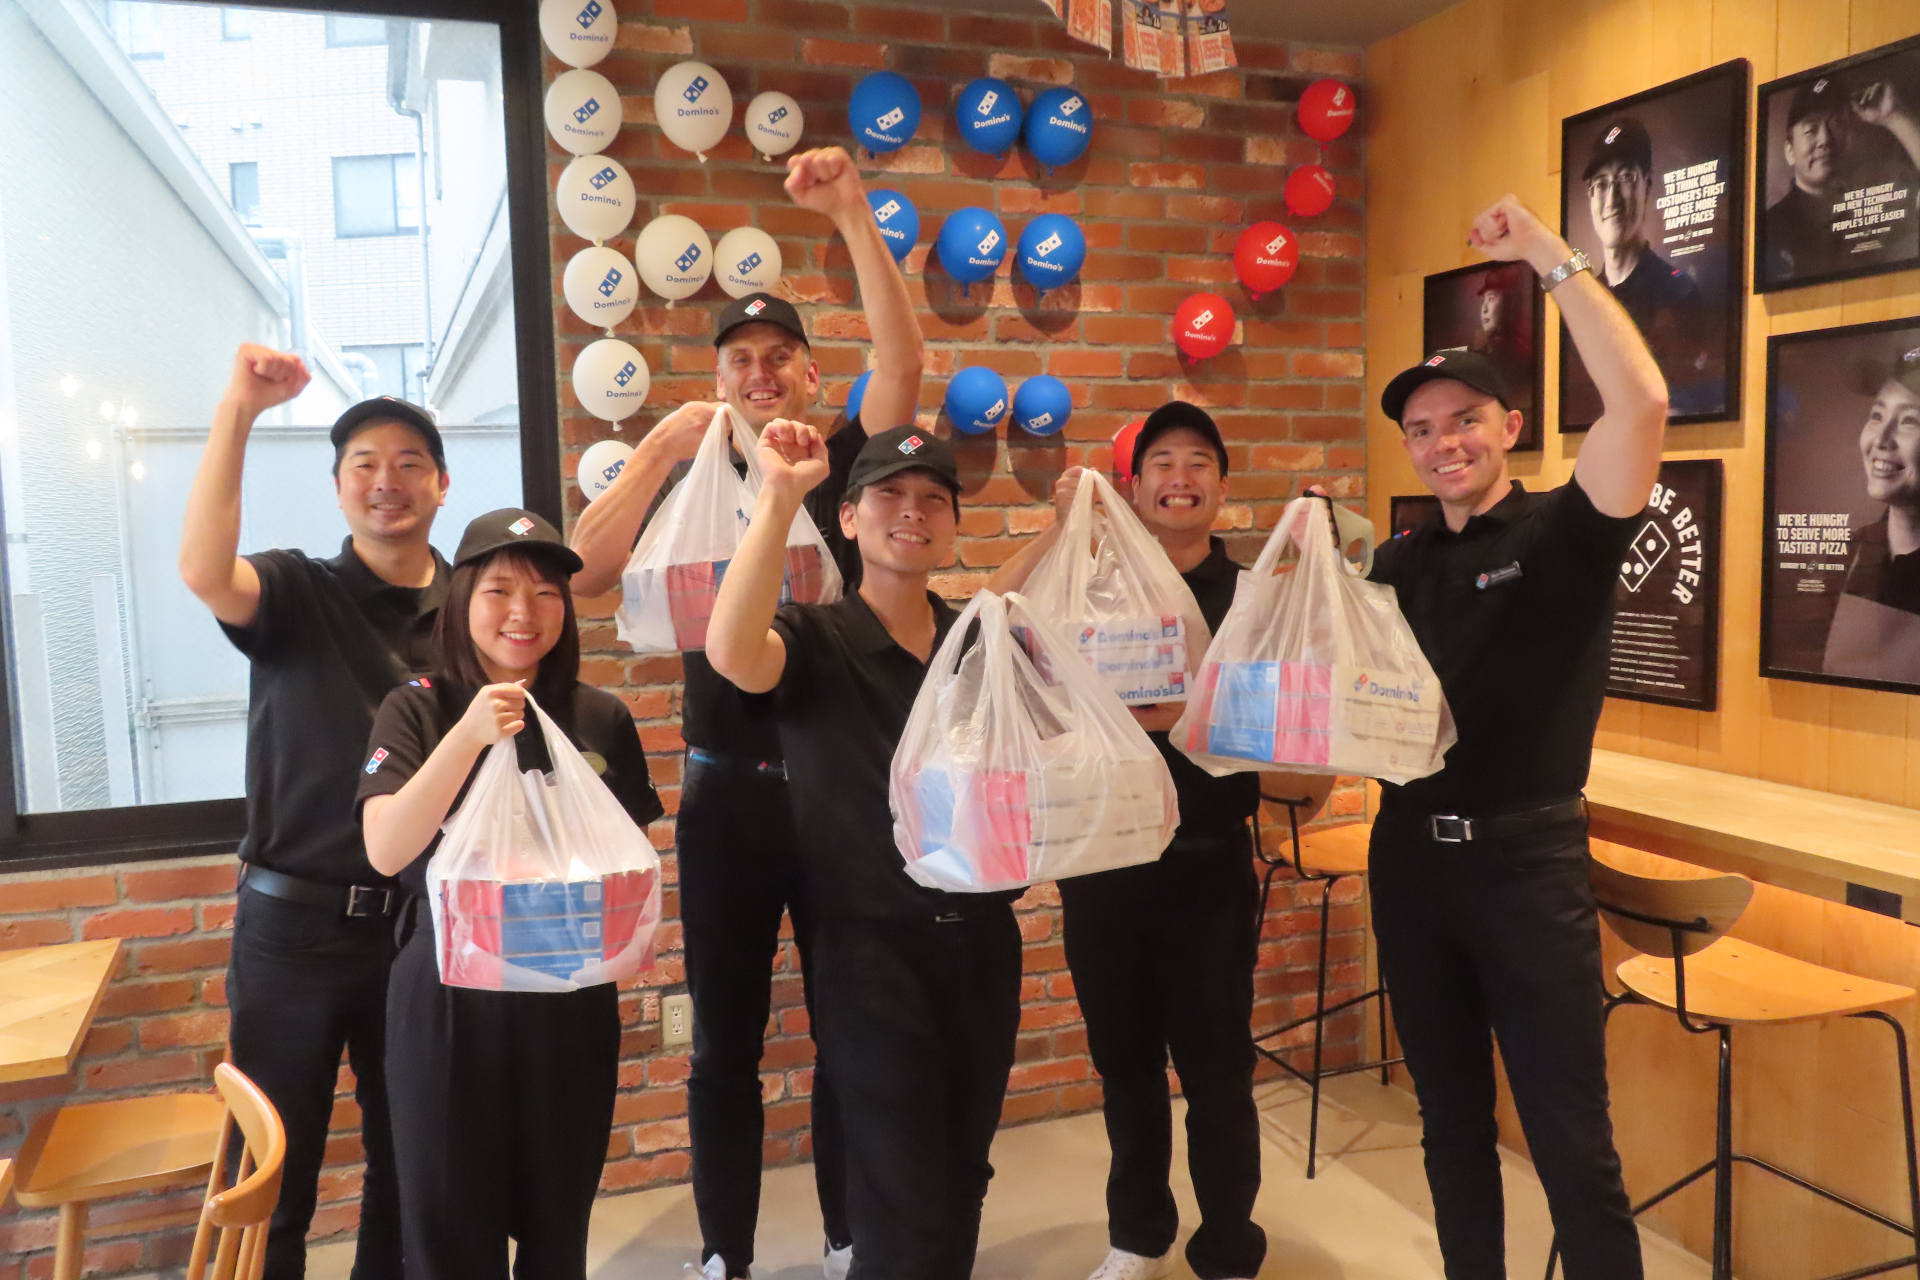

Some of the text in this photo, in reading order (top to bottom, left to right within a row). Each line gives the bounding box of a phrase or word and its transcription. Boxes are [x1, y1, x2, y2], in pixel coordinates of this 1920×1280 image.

[570, 32, 609, 43] Domino's
[677, 107, 720, 117] Domino's
[974, 114, 1010, 129] Domino's
[1050, 116, 1086, 134] Domino's
[564, 124, 605, 137] Domino's
[757, 124, 790, 138] Domino's
[865, 128, 902, 144] Domino's
[1664, 159, 1718, 184] WE'RE HUNGRY
[1665, 172, 1716, 196] TO THINK OUR
[1656, 182, 1726, 210] CUSTOMER'S FIRST
[1844, 182, 1894, 202] WE'RE HUNGRY
[581, 193, 622, 207] Domino's
[1832, 188, 1908, 213] FOR NEW TECHNOLOGY
[1663, 196, 1718, 220] AND SEE MORE
[1854, 204, 1884, 218] TO MAKE
[1665, 208, 1714, 230] HAPPY FACES
[1832, 218, 1863, 232] PEOPLE'S
[1864, 214, 1880, 226] LIFE
[1880, 209, 1905, 222] EASIER
[878, 227, 906, 240] mino's
[968, 256, 1000, 266] Domino's
[1027, 256, 1064, 272] Domino's
[1256, 256, 1290, 268] Domino's
[666, 274, 704, 283] Domino's
[728, 275, 764, 288] Domino's
[594, 298, 631, 309] Domino's
[1185, 330, 1216, 342] Domino's
[606, 390, 642, 398] Domino's
[1778, 514, 1850, 527] WE'RE HUNGRY
[1776, 528, 1851, 541] TO SERVE MORE
[1649, 482, 1702, 605] BE BETTER
[1779, 542, 1848, 555] TASTIER PIZZA
[1115, 686, 1170, 700] omino's
